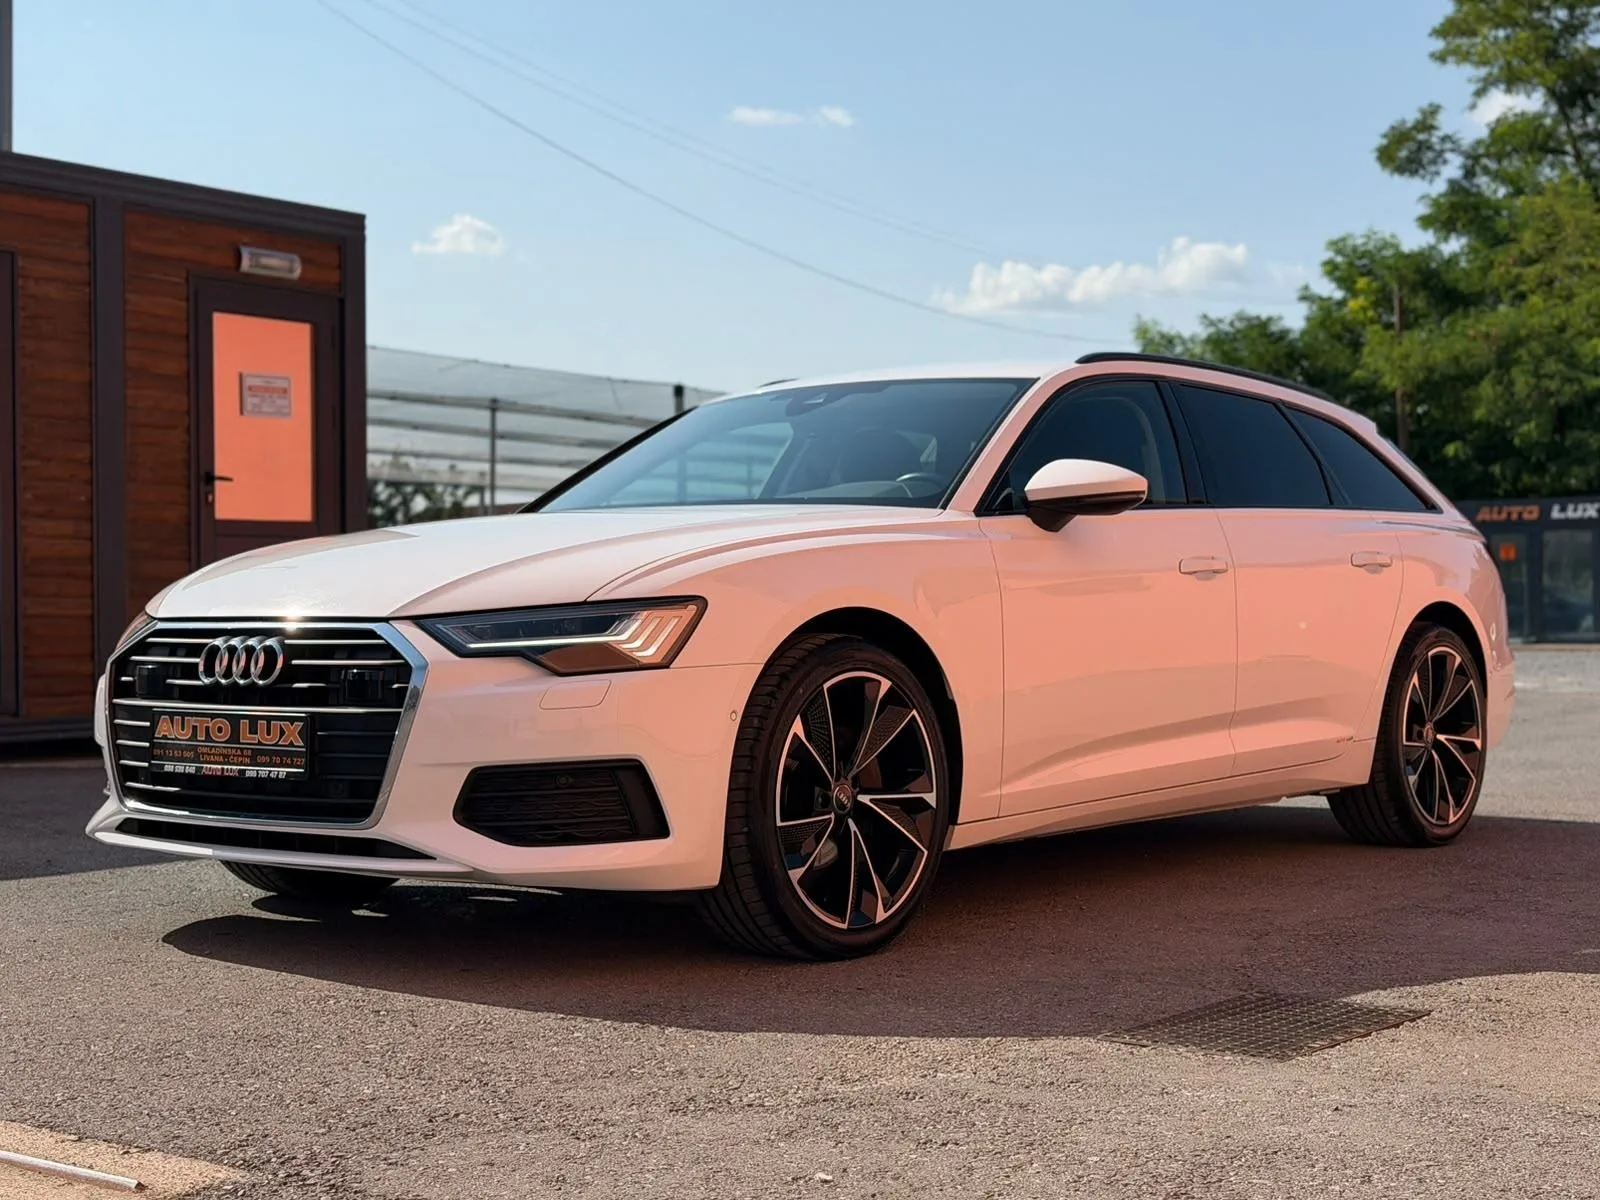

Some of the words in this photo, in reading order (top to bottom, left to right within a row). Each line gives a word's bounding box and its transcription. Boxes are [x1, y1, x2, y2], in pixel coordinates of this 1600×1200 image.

[1475, 505, 1541, 521] AUTO
[1550, 502, 1600, 520] LUX
[154, 715, 231, 742] AUTO
[240, 719, 304, 746] LUX
[201, 765, 221, 775] AUTO
[223, 767, 239, 776] LUX
